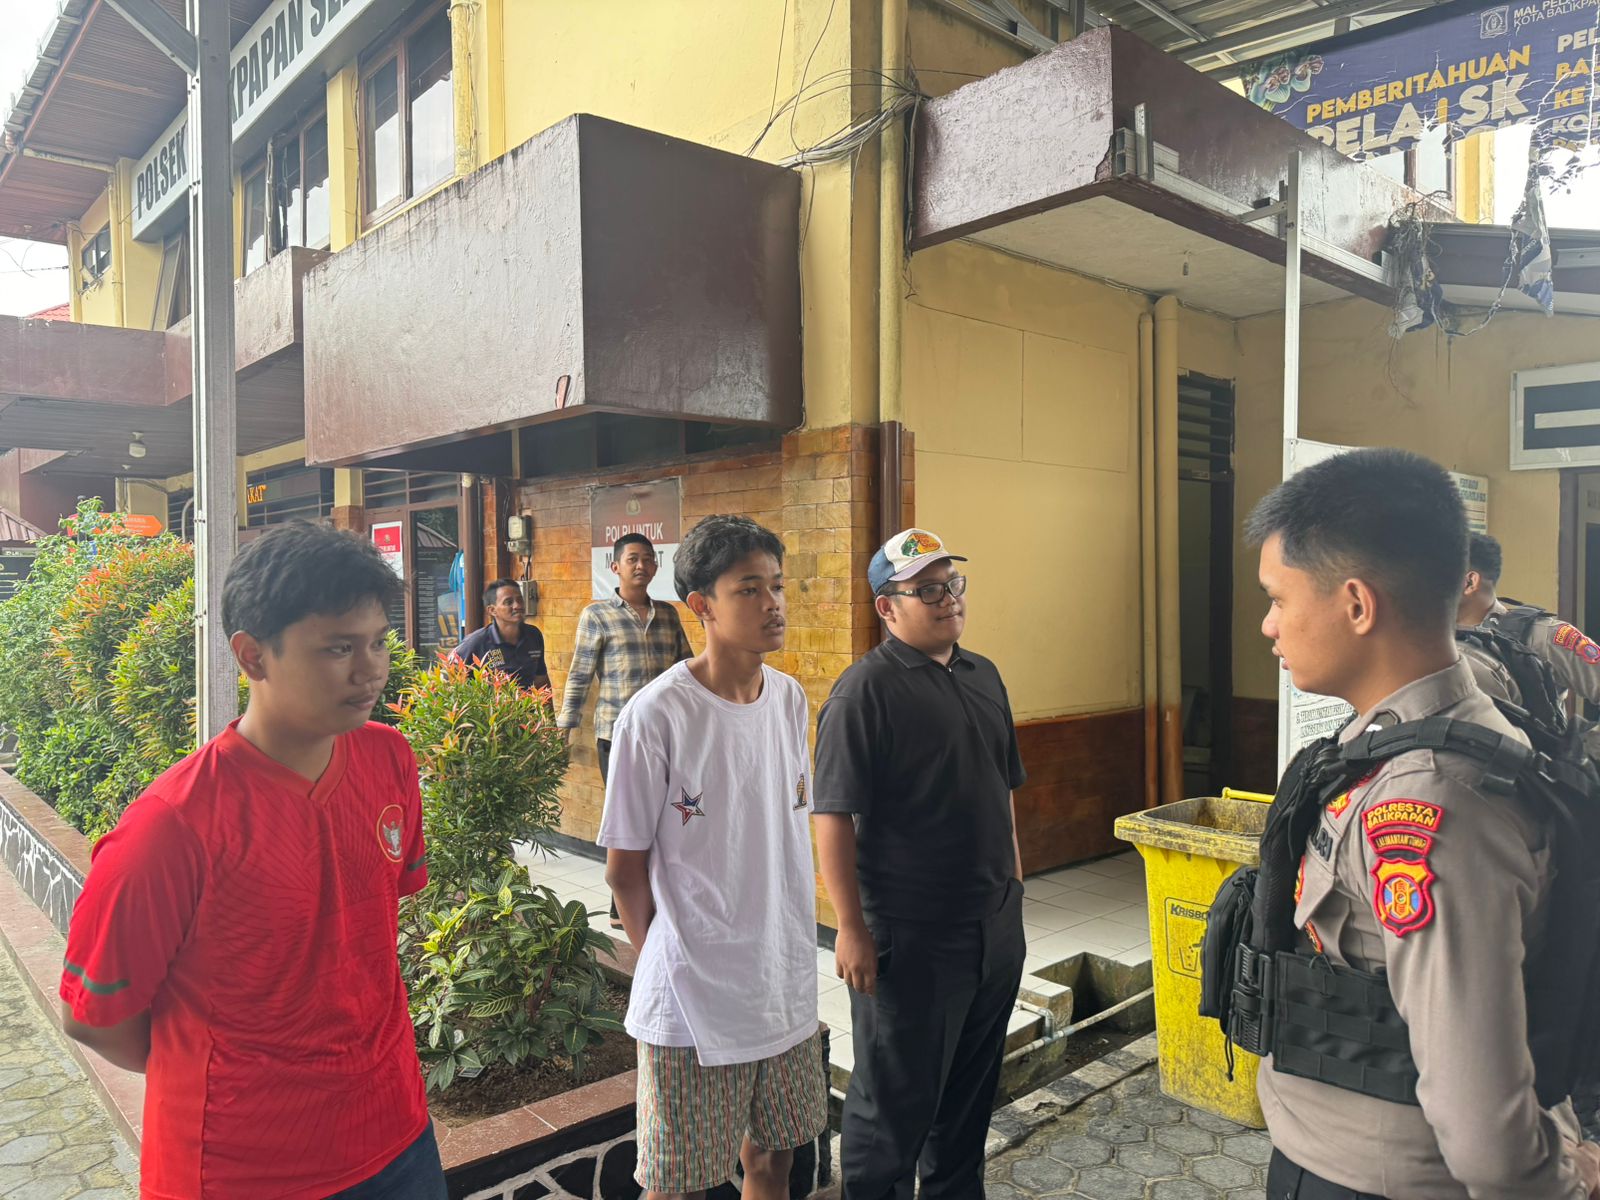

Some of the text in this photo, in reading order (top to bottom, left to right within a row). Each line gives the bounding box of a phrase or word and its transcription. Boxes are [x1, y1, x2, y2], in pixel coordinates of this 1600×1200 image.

[1513, 11, 1545, 27] KOTA
[1514, 5, 1539, 18] MAL
[1306, 44, 1530, 124] PEMBERITAHUAN
[1458, 73, 1529, 126] SK
[1554, 86, 1585, 110] KE
[137, 0, 304, 220] POLSEK KPAPAN
[1367, 803, 1433, 819] POLRESTA
[1367, 811, 1435, 829] BALIKPAPAN
[1170, 904, 1208, 920] KRISBO
